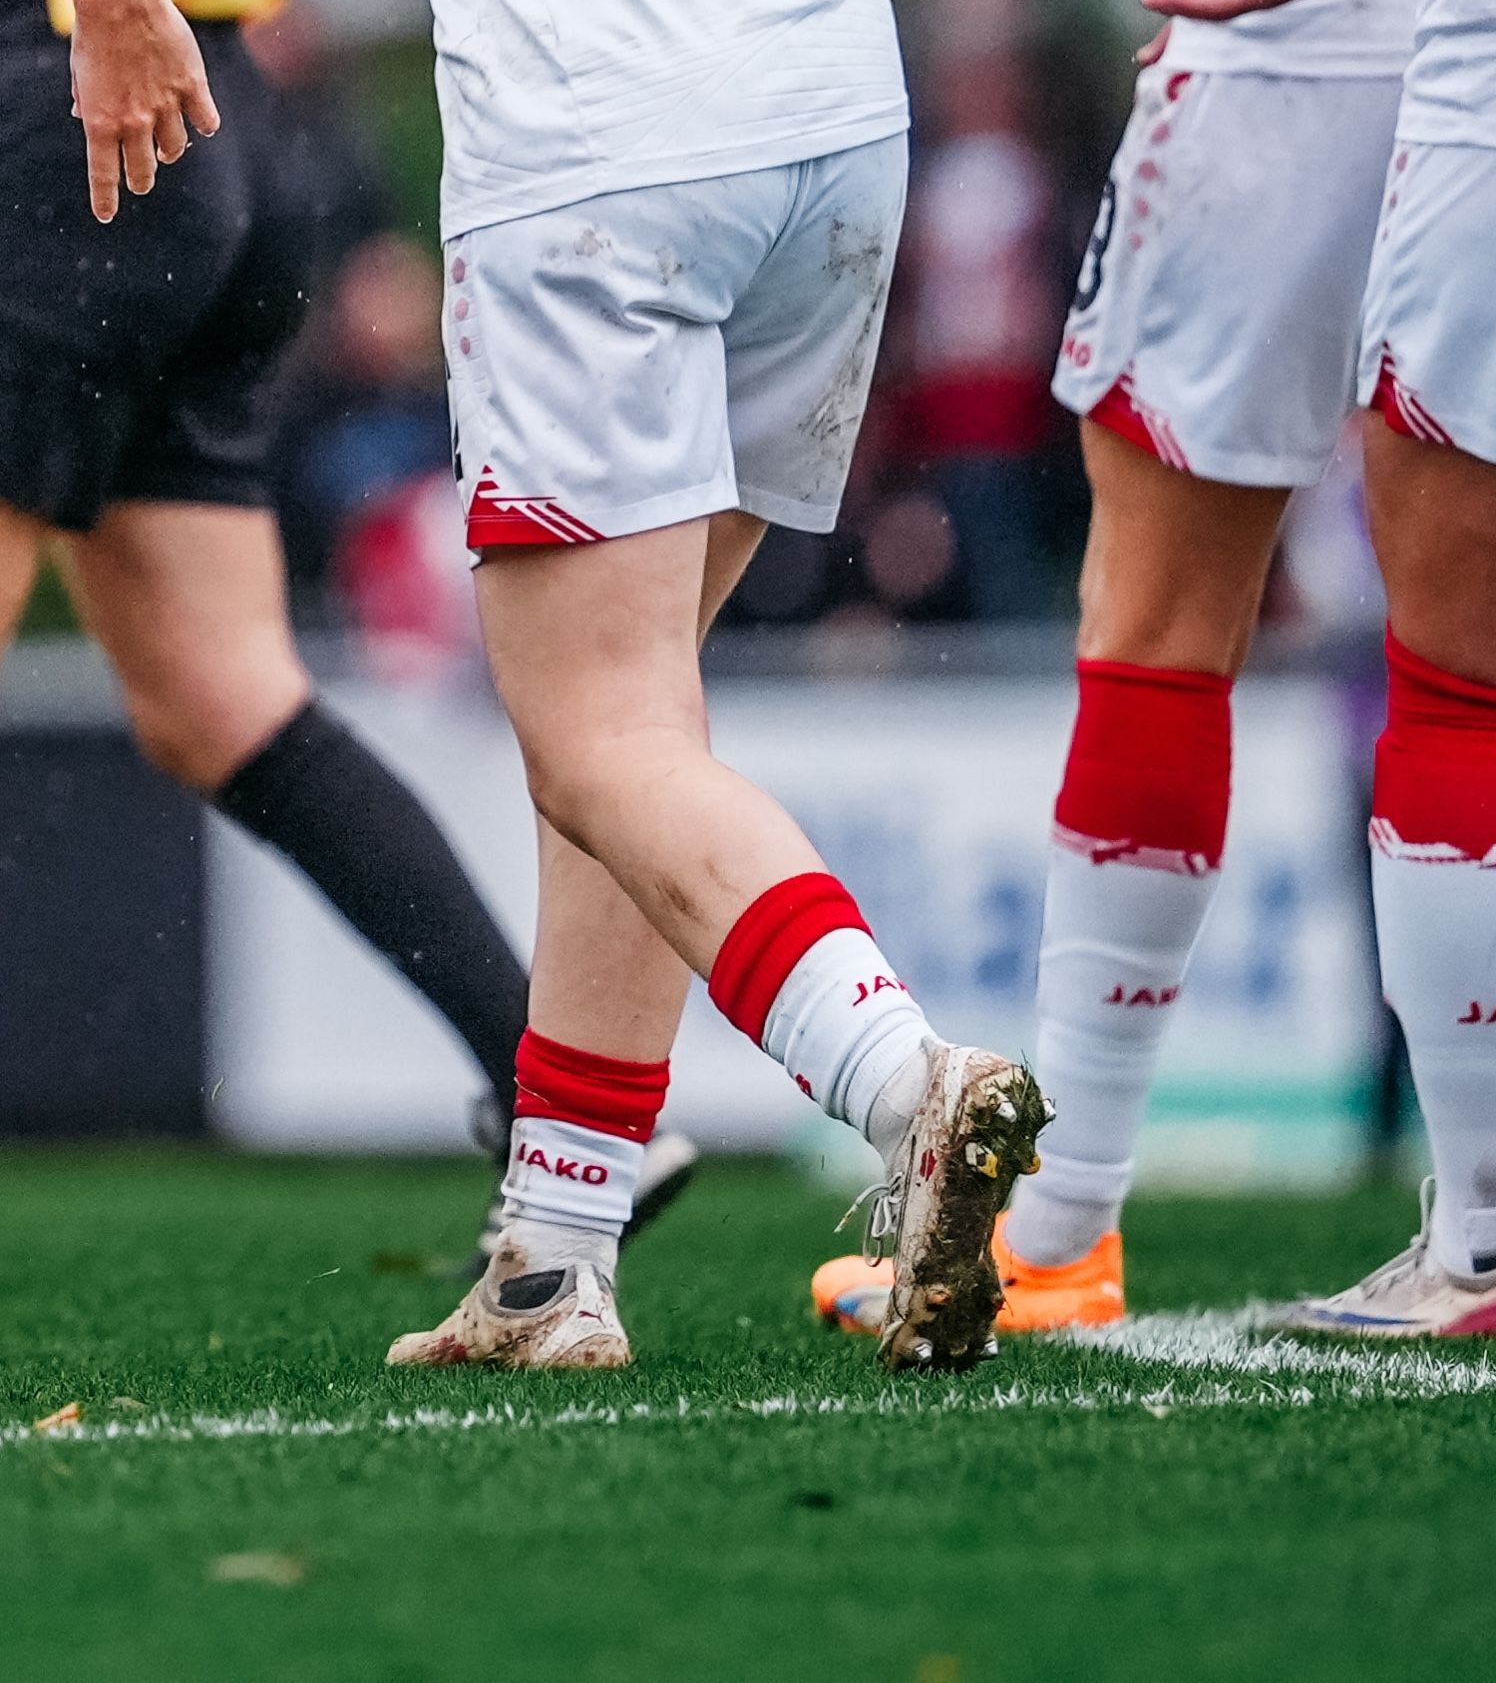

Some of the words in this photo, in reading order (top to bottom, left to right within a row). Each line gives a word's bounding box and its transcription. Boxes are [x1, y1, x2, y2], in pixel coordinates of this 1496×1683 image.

[852, 974, 909, 1007] JA
[1104, 982, 1180, 1009] JAK
[517, 1142, 608, 1186] JAKO
